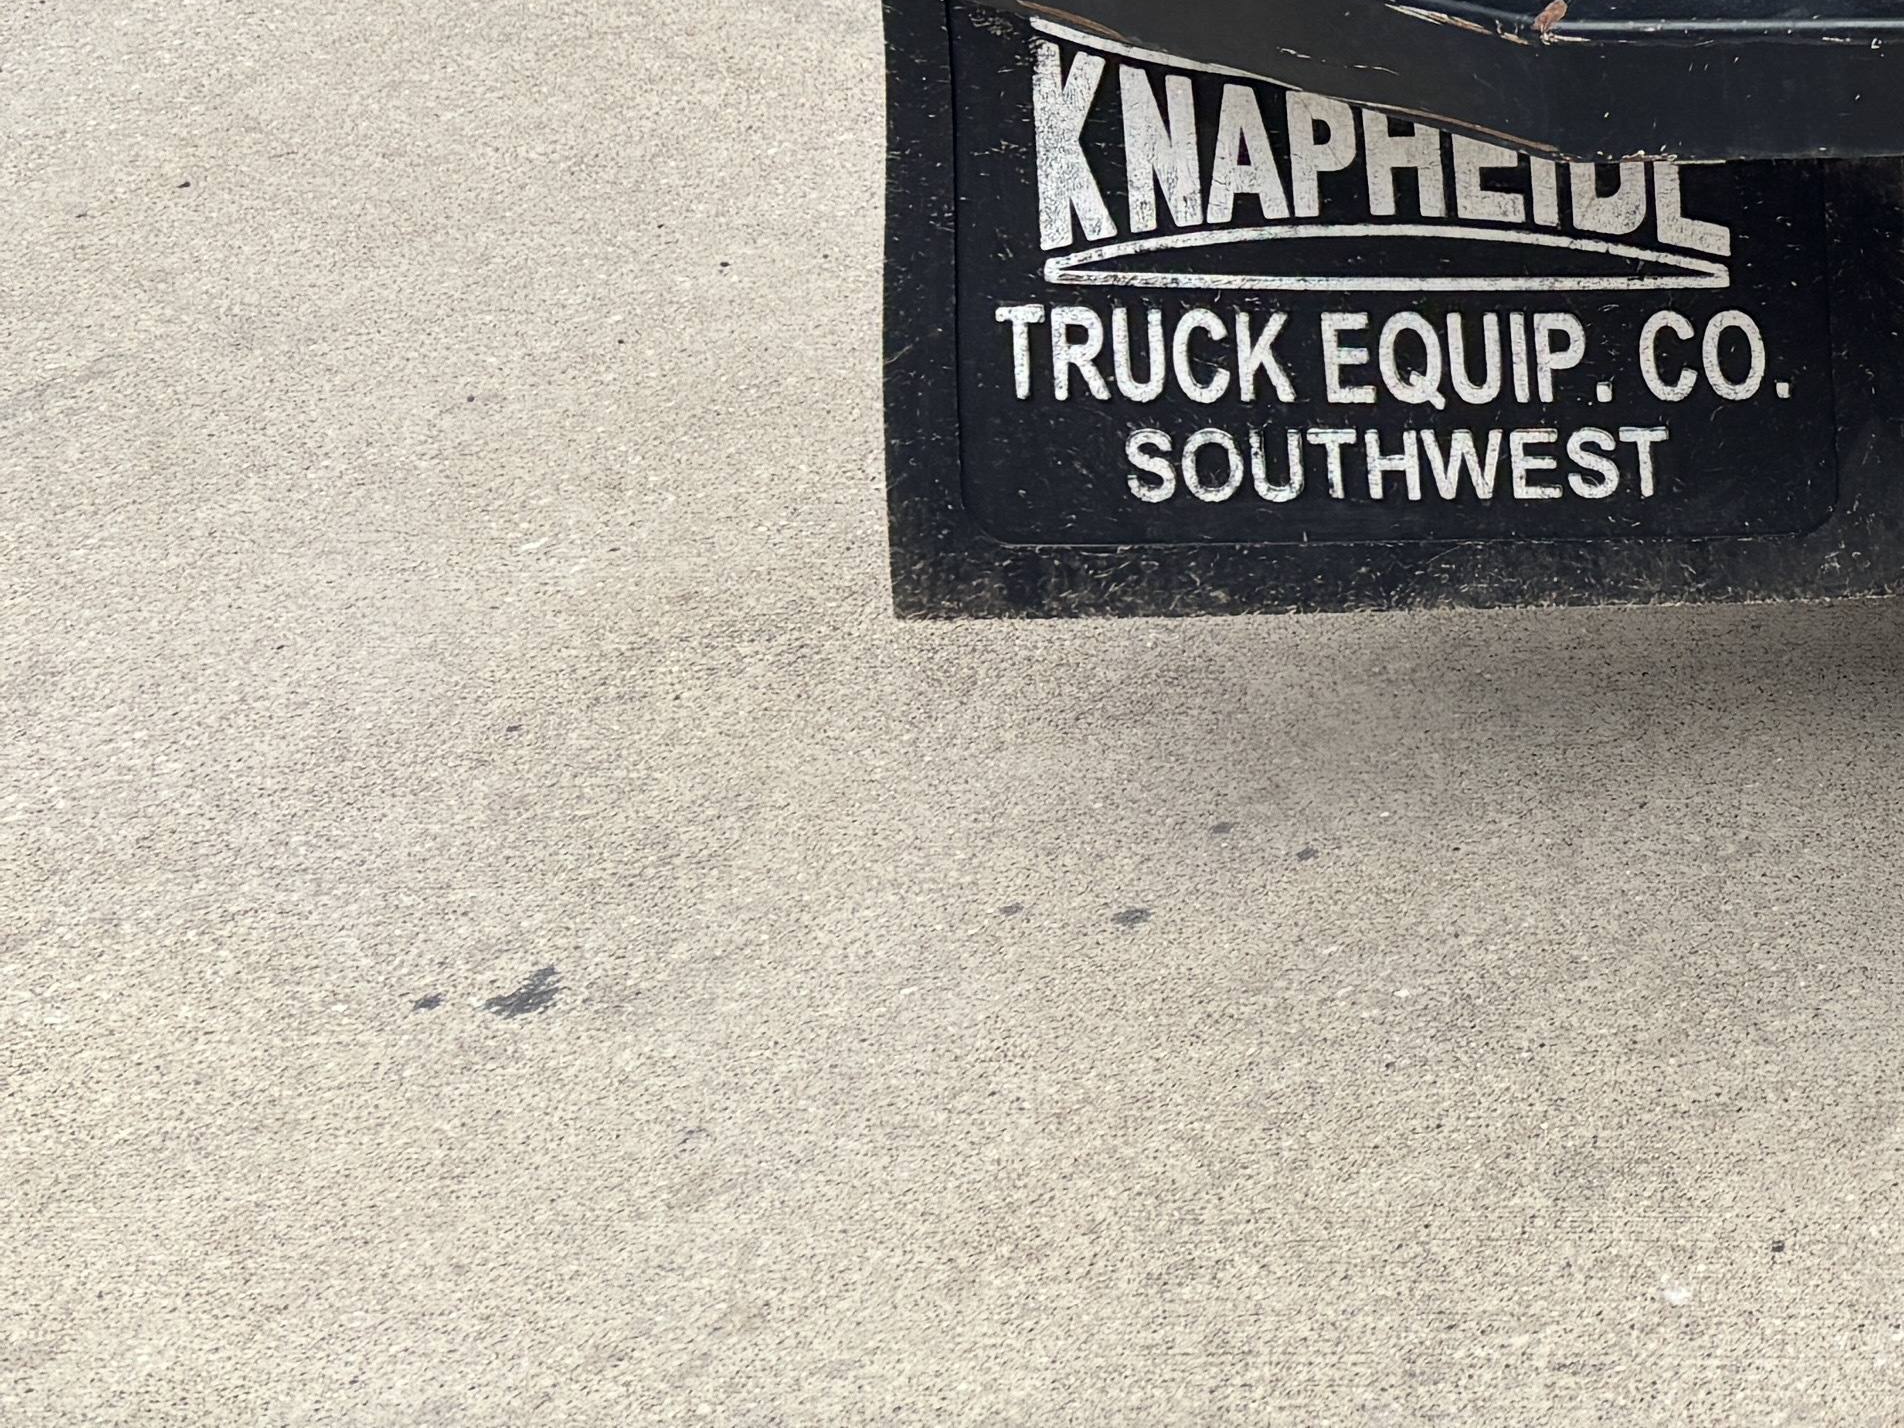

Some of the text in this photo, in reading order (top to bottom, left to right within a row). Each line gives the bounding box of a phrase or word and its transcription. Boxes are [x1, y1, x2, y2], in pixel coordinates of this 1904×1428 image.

[995, 302, 1793, 411] TRUCK EQUIP. CO.
[1125, 424, 1669, 505] SOUTHWEST
